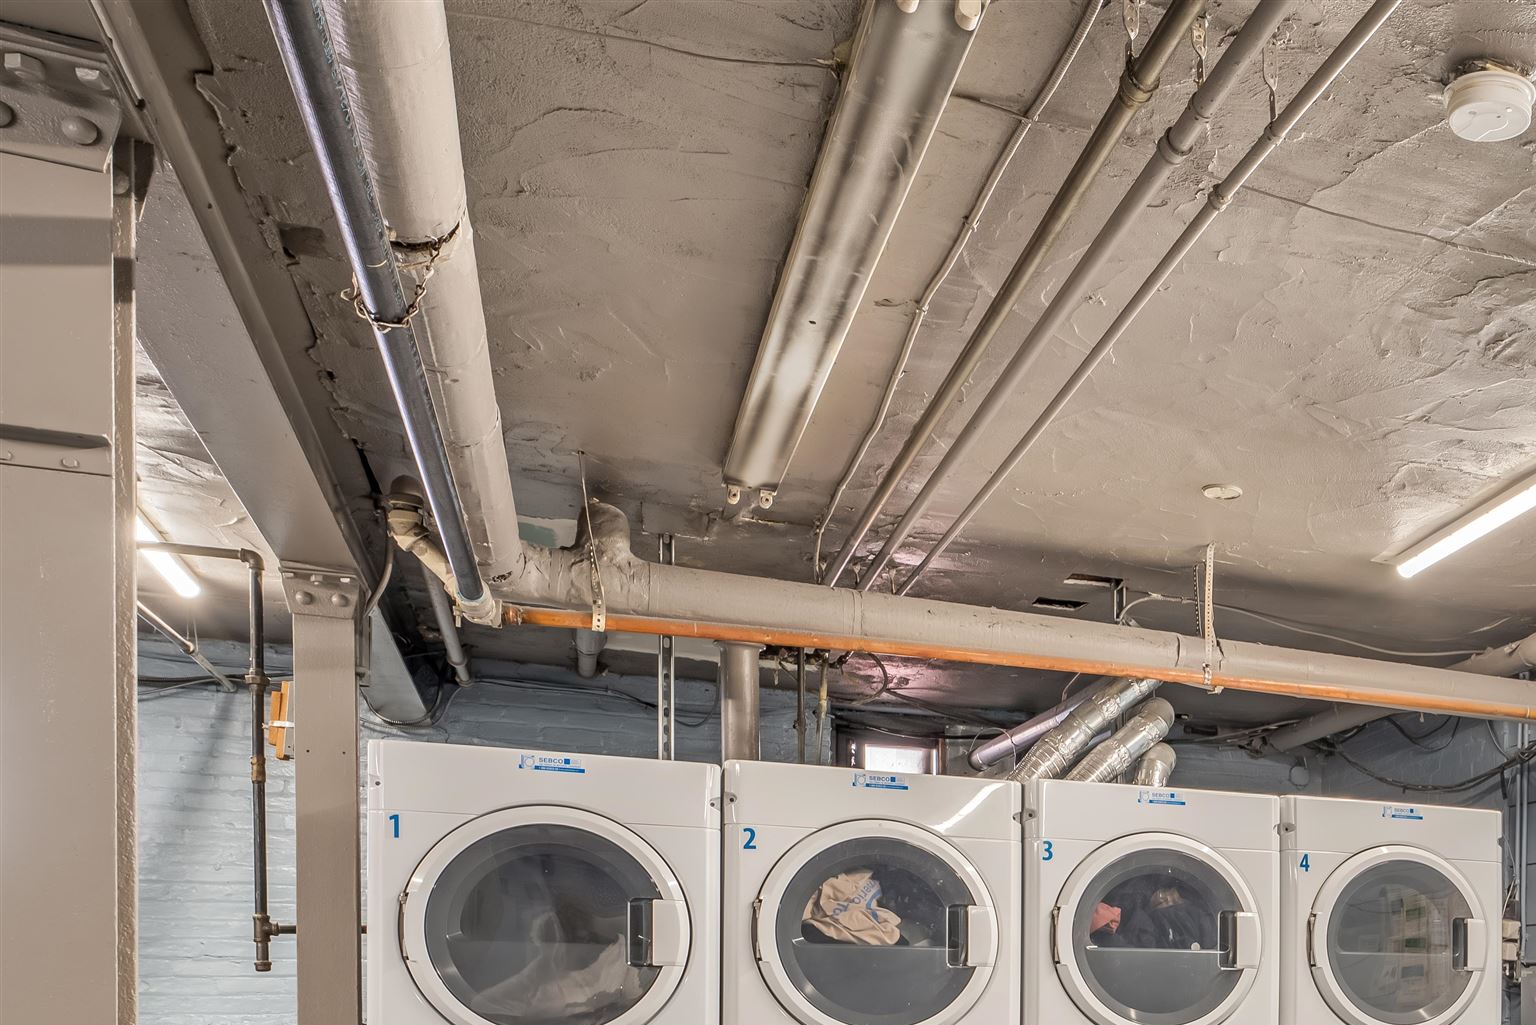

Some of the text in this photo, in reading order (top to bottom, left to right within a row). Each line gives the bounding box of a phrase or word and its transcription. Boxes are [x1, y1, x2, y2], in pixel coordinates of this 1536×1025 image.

[539, 757, 563, 765] SEBCO
[389, 814, 400, 838] 1
[743, 828, 757, 849] 2
[1042, 841, 1053, 861] 3
[1300, 853, 1310, 872] 4
